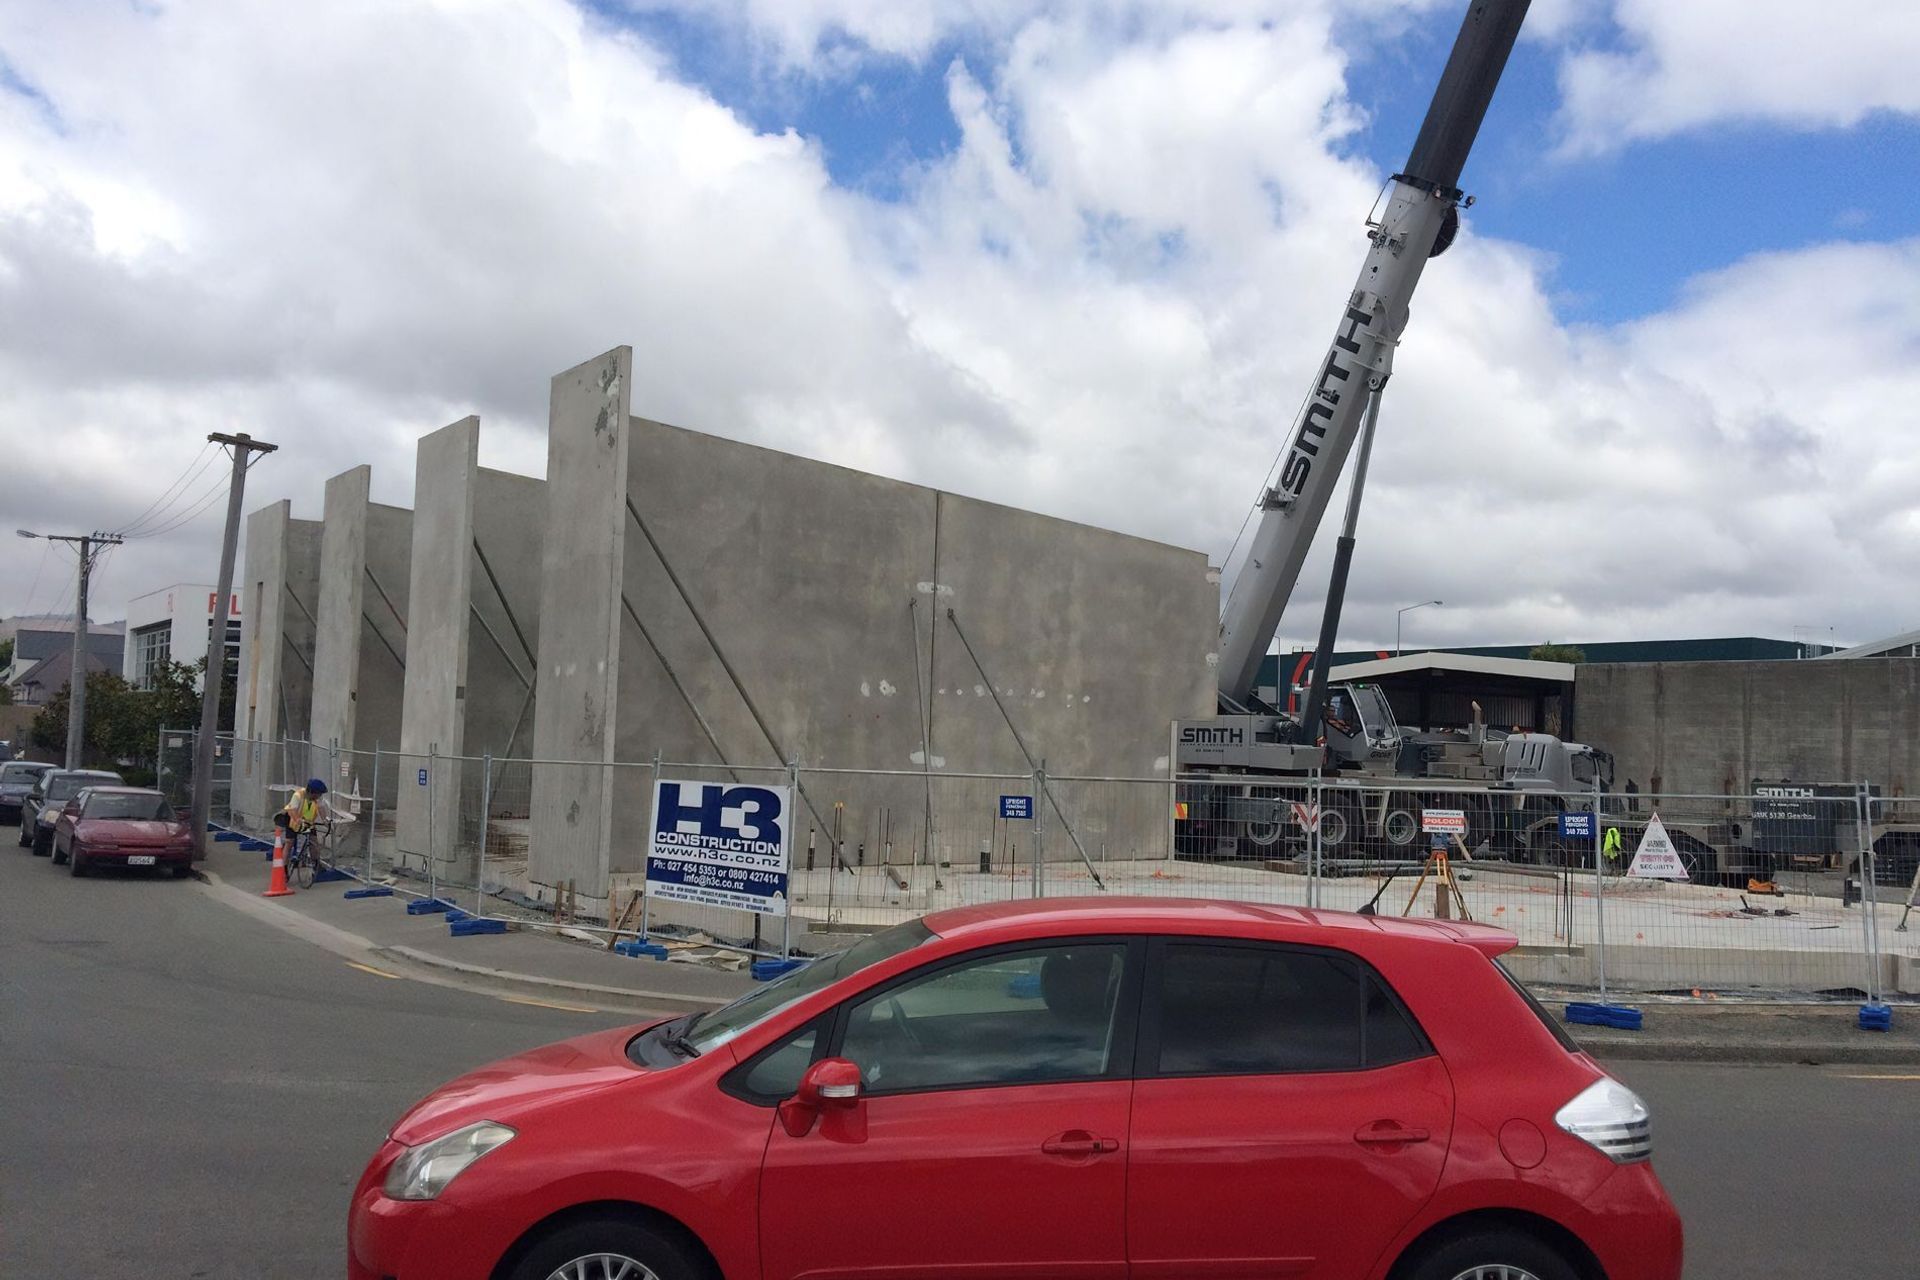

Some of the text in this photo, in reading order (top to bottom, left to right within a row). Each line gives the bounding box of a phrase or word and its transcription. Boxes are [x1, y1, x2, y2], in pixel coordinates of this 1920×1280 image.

[1281, 308, 1373, 496] SMITH
[1179, 728, 1243, 743] SMITH
[1753, 787, 1815, 799] SMITH
[656, 782, 782, 842] H3
[1423, 817, 1462, 825] POLCON
[656, 832, 780, 855] CONSTRUCTION
[655, 846, 780, 868] www.h3c.co.nz
[653, 859, 779, 885] Ph: 027 454 5353 or 0800 427414
[683, 873, 745, 891] info@h3c.co.nz
